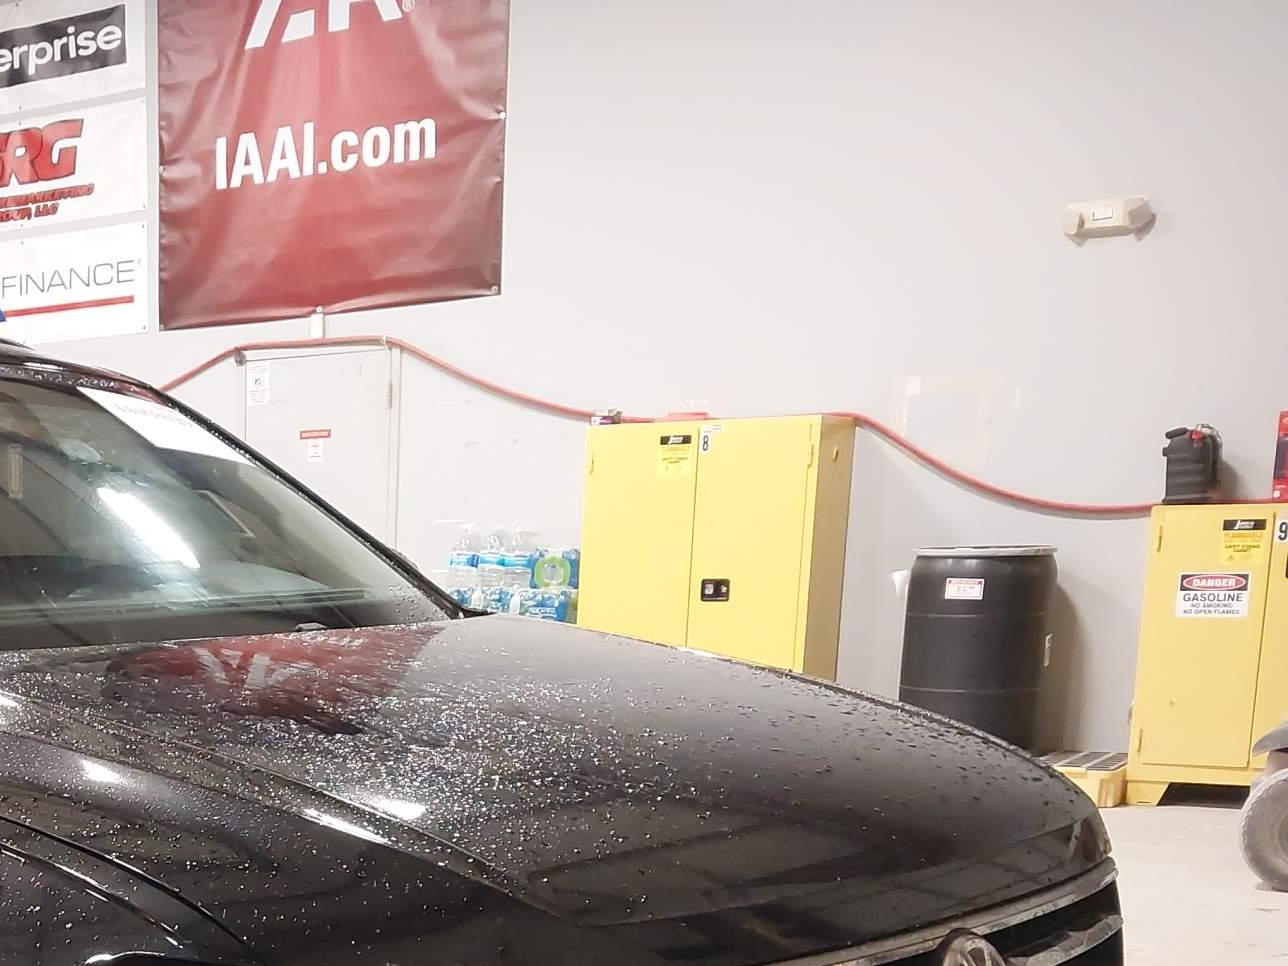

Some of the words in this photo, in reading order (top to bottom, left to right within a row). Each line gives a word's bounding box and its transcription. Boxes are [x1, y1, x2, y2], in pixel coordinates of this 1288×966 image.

[215, 117, 437, 190] IAAI.com
[1, 260, 135, 299] FINANCE
[702, 435, 709, 451] 8
[1278, 522, 1288, 541] 9
[1192, 578, 1236, 587] DANGER
[1183, 592, 1244, 602] GASOLINE
